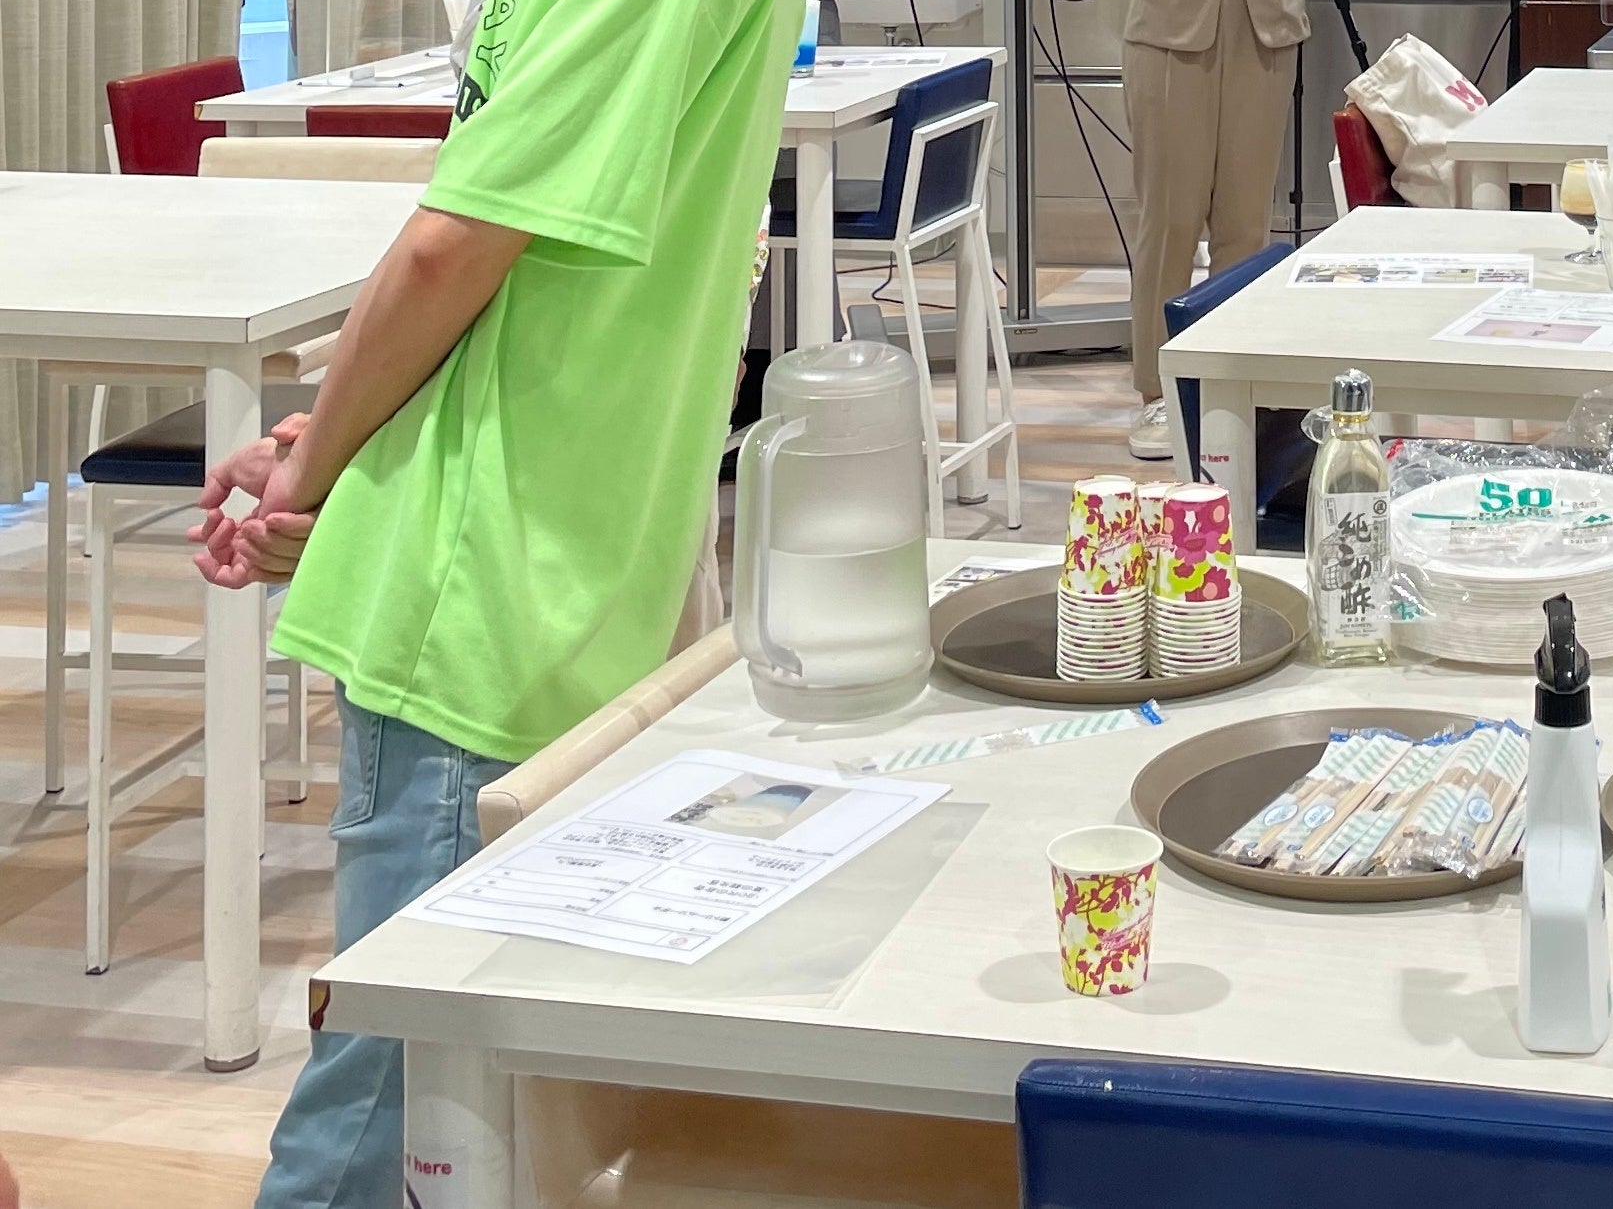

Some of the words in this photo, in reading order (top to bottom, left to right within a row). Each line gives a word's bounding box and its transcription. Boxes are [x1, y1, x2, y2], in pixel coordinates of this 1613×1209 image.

[1207, 453, 1230, 463] here
[1479, 477, 1552, 512] 50
[414, 1156, 453, 1175] here
